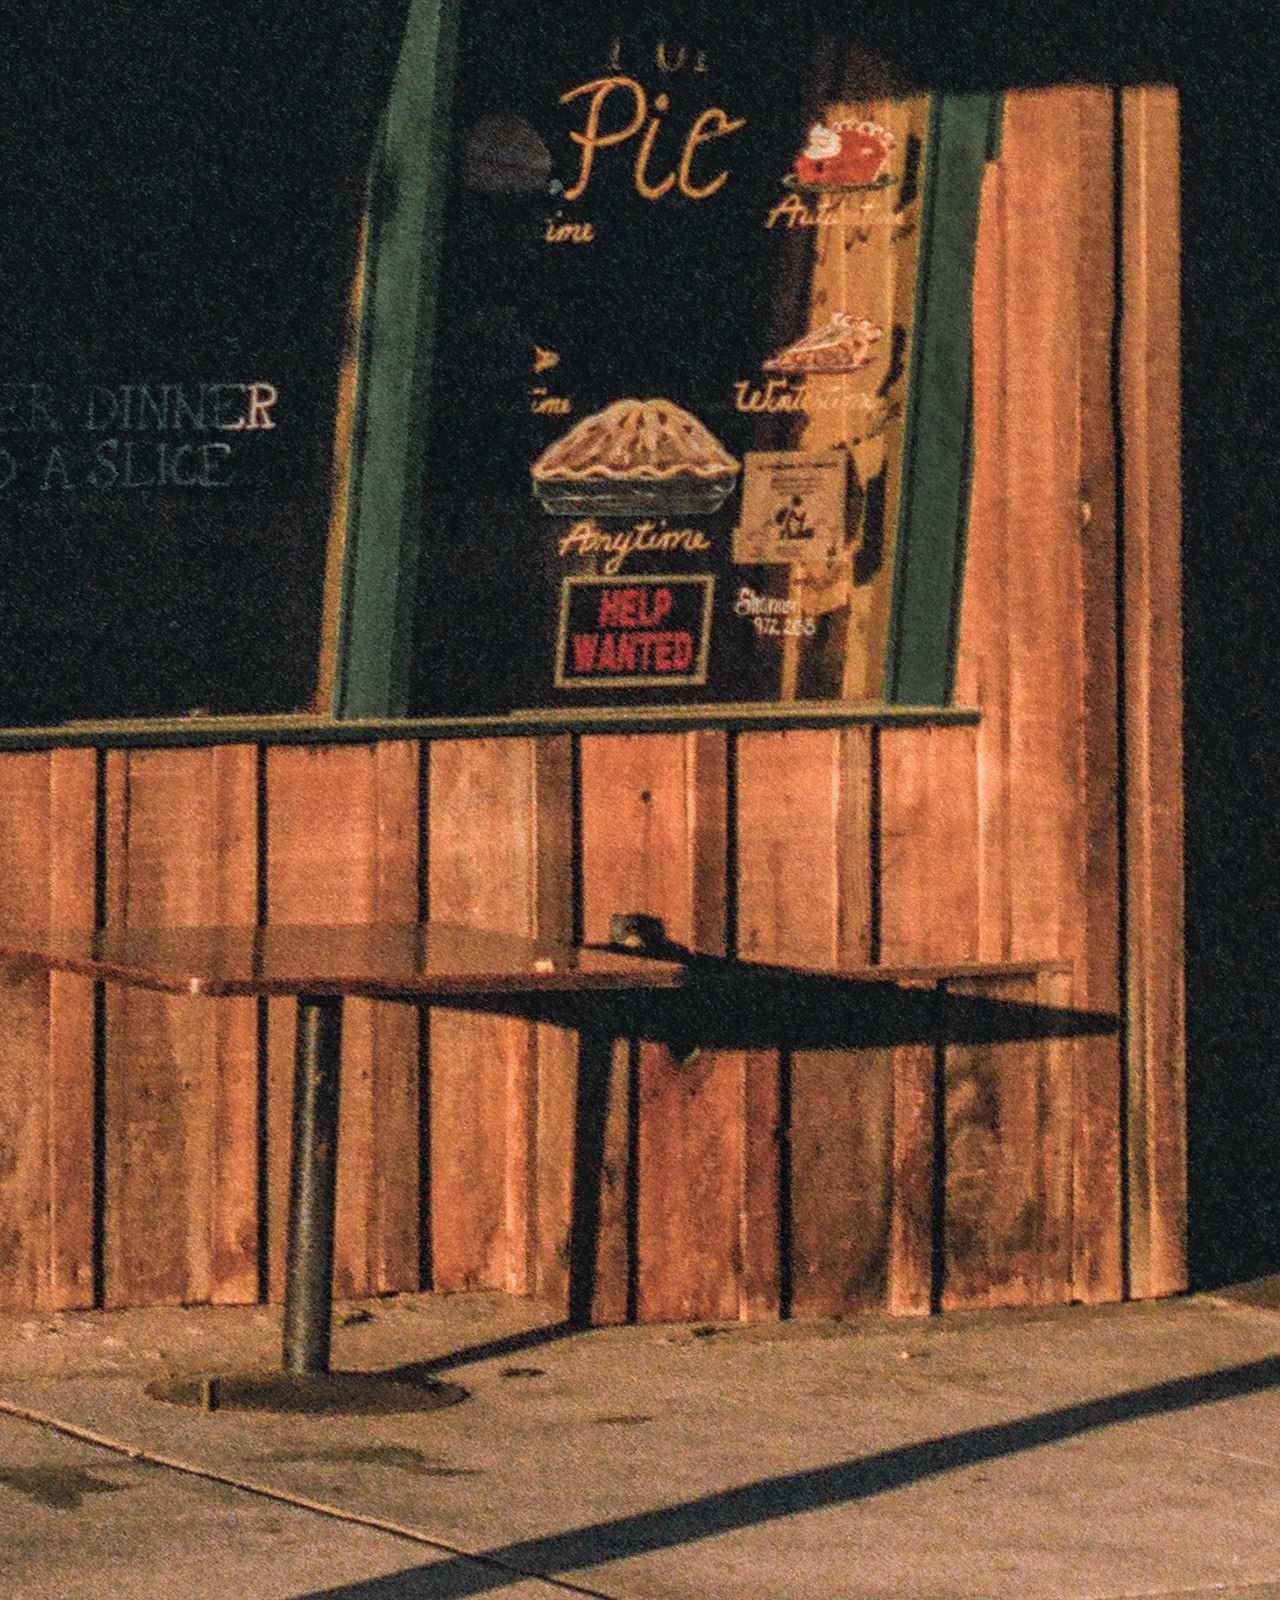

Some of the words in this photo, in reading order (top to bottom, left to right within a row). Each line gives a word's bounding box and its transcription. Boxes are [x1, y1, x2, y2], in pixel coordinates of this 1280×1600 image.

[82, 379, 280, 435] DINNER
[38, 442, 75, 493] A
[86, 437, 235, 492] SLICE
[557, 517, 712, 575] Anytime
[598, 587, 676, 629] HELP
[571, 632, 695, 674] WANTED
